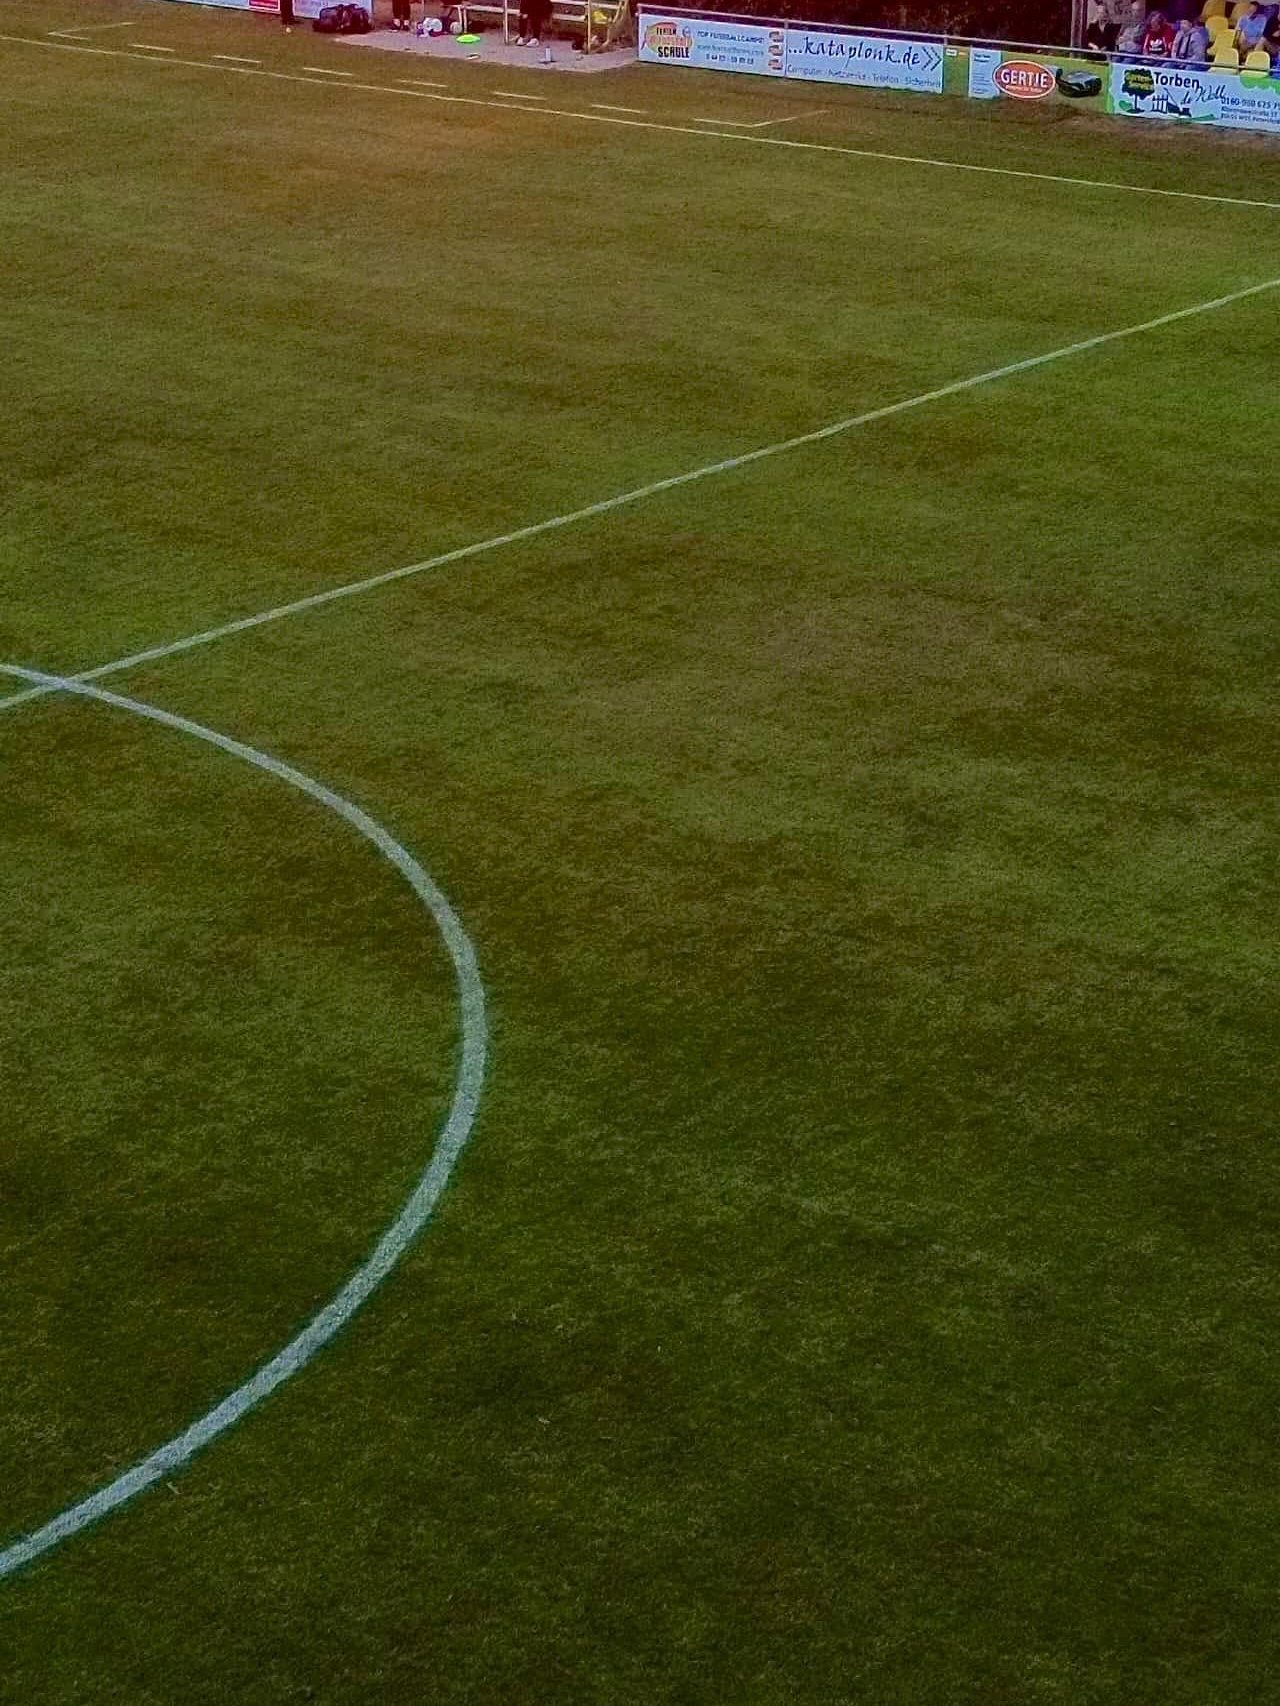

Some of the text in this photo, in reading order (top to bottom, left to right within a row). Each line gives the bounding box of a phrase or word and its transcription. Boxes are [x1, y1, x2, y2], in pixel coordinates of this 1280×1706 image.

[657, 46, 690, 59] SCHULE
[1000, 68, 1049, 88] GERTIE
[1154, 71, 1200, 90] Torben
